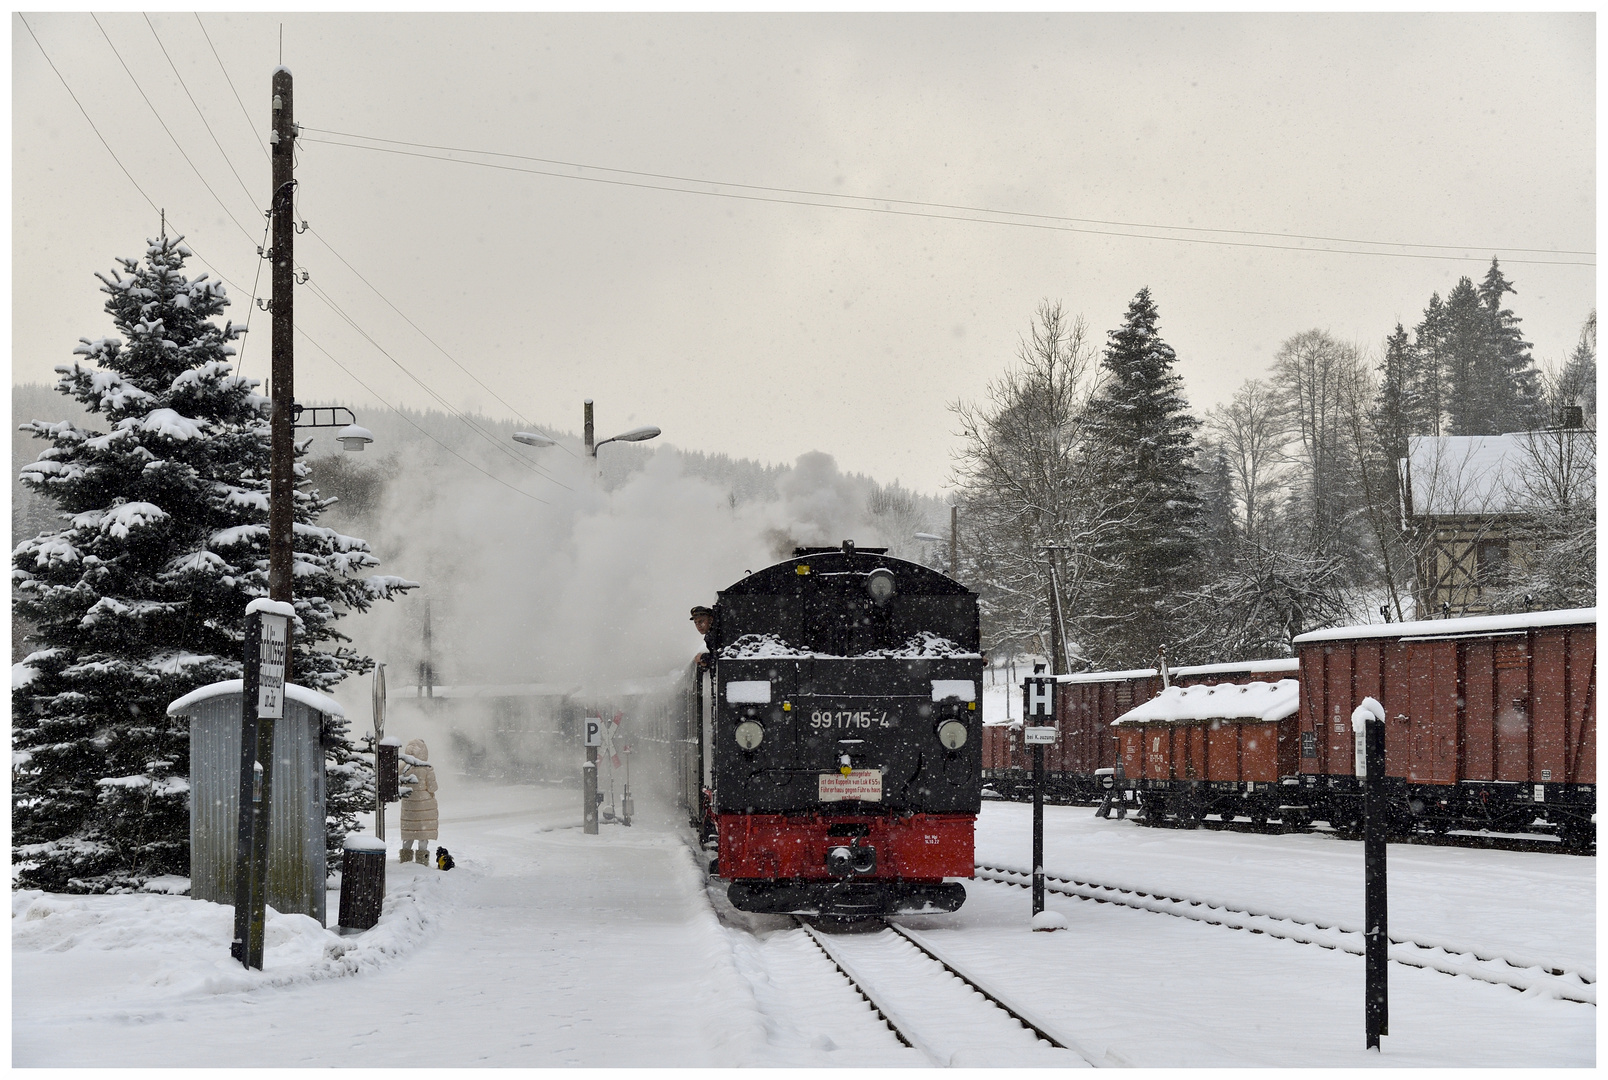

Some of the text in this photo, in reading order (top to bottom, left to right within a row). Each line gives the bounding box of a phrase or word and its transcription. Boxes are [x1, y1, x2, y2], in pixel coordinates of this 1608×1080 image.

[1029, 683, 1053, 715] H
[810, 711, 890, 728] 99 1715-4
[587, 722, 599, 743] P
